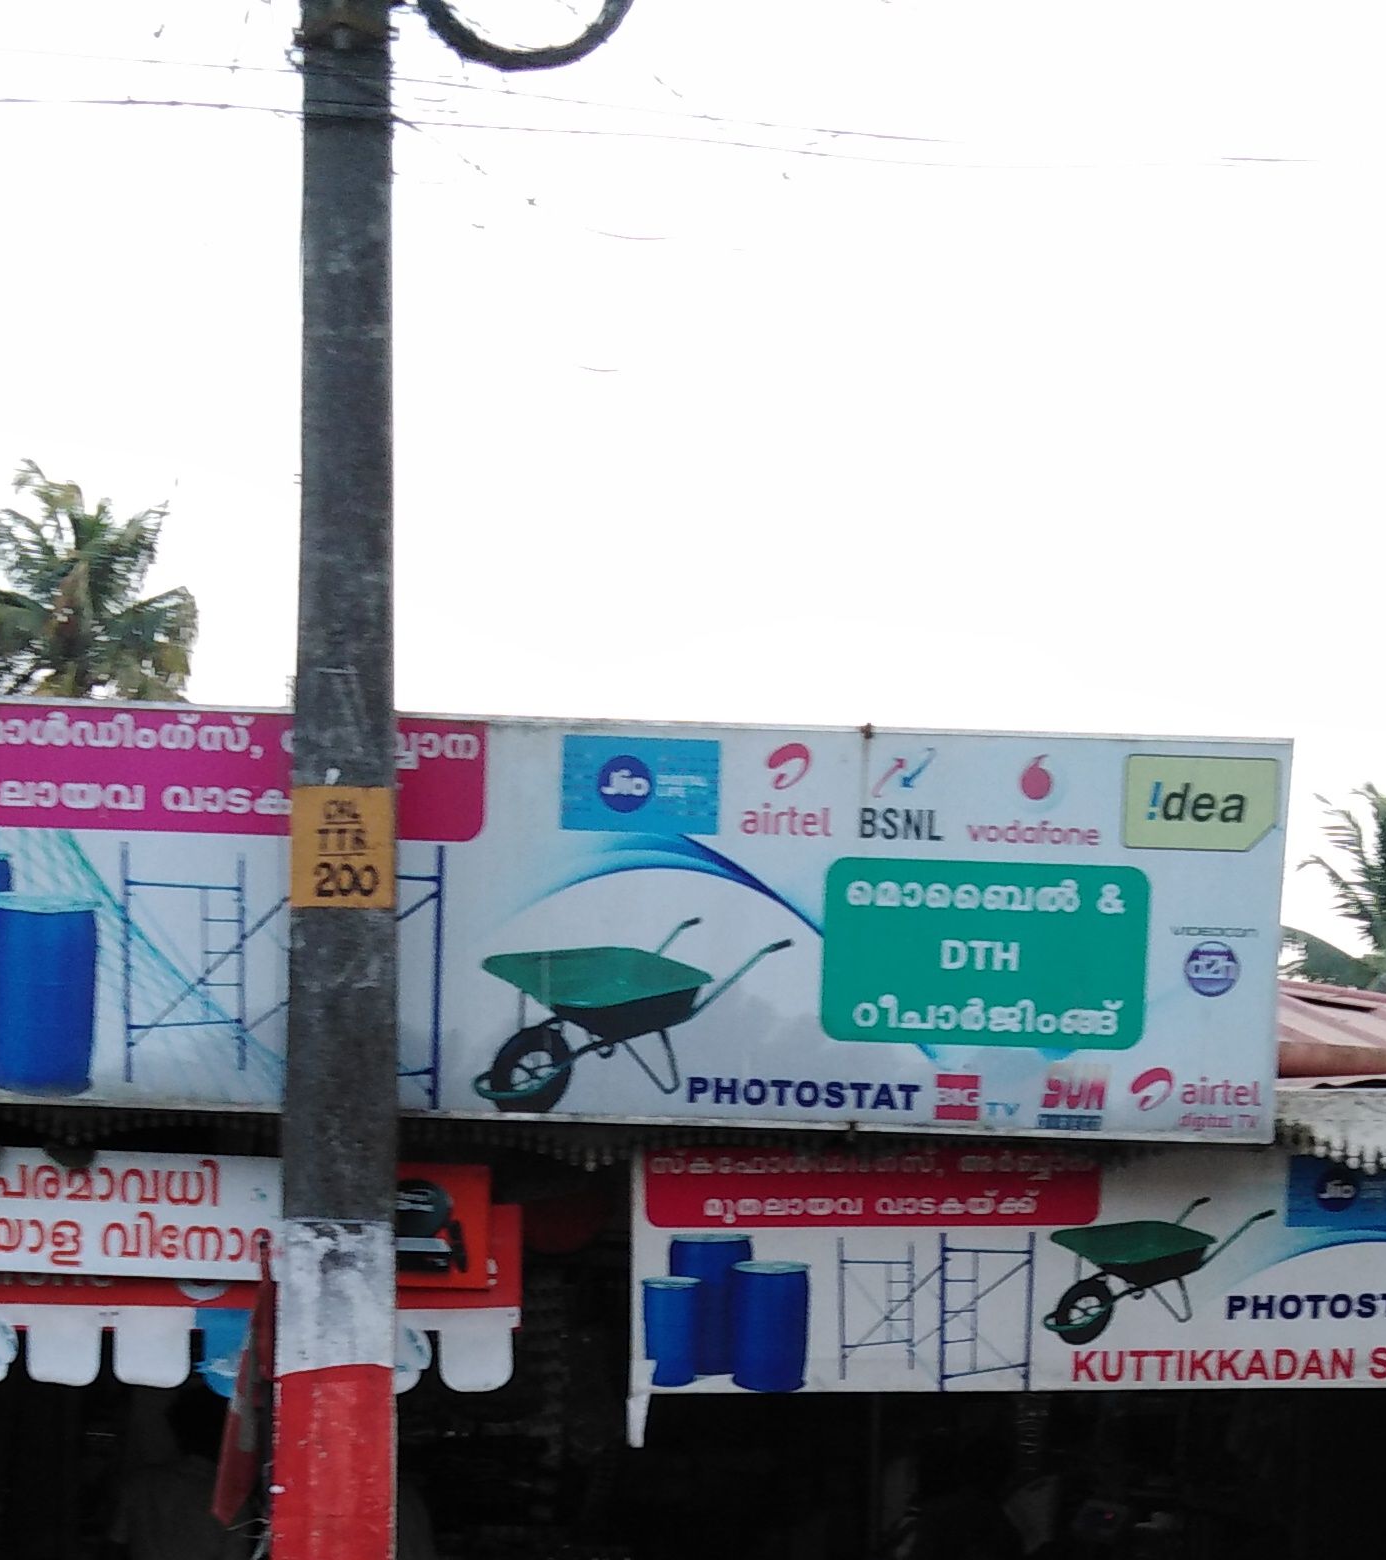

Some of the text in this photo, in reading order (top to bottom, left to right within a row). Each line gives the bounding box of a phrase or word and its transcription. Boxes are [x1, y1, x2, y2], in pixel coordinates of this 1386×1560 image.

[600, 768, 651, 797] Jio
[740, 802, 833, 837] airtel
[858, 806, 944, 842] BSNL
[966, 820, 1101, 846] vodafone
[313, 862, 380, 897] 200
[1096, 883, 1126, 914] &
[940, 938, 1021, 972] DTH
[686, 1076, 922, 1111] PHOTOSTAT
[1180, 1076, 1261, 1108] airtel
[1070, 1347, 1356, 1383] KUTTIKKADAN
